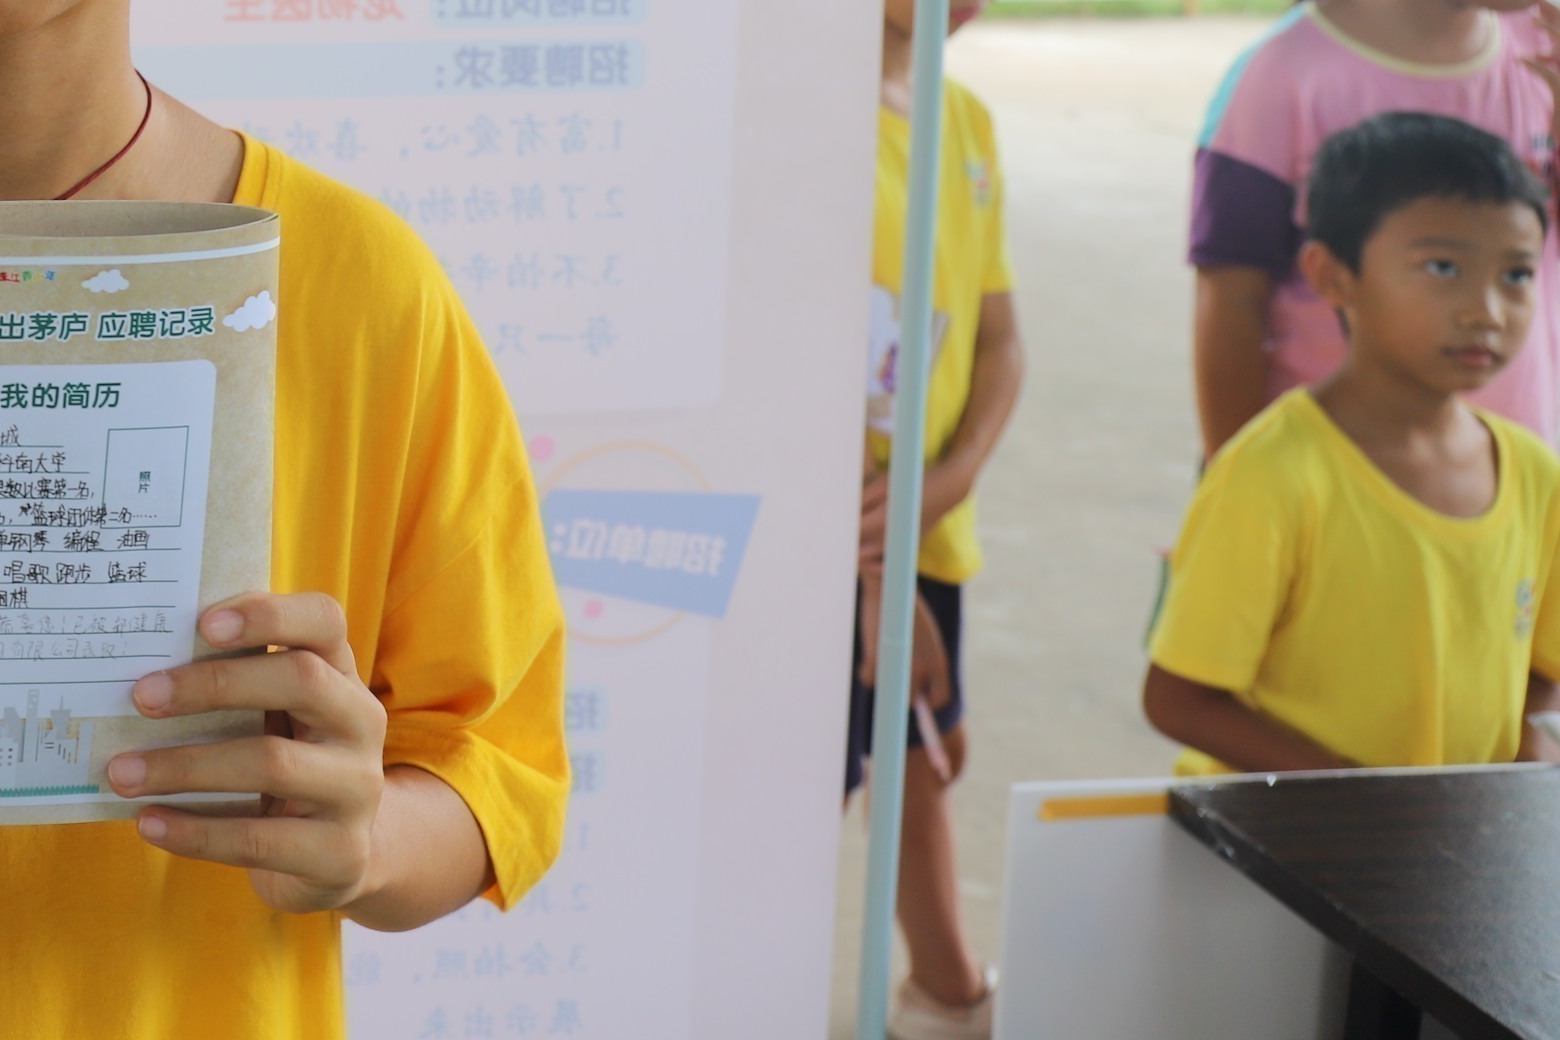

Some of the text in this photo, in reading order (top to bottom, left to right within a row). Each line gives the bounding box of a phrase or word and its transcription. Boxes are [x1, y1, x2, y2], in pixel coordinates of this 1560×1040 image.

[97, 307, 215, 341] 应聘记录
[0, 381, 122, 409] 我的简历
[138, 470, 152, 494] 照片
